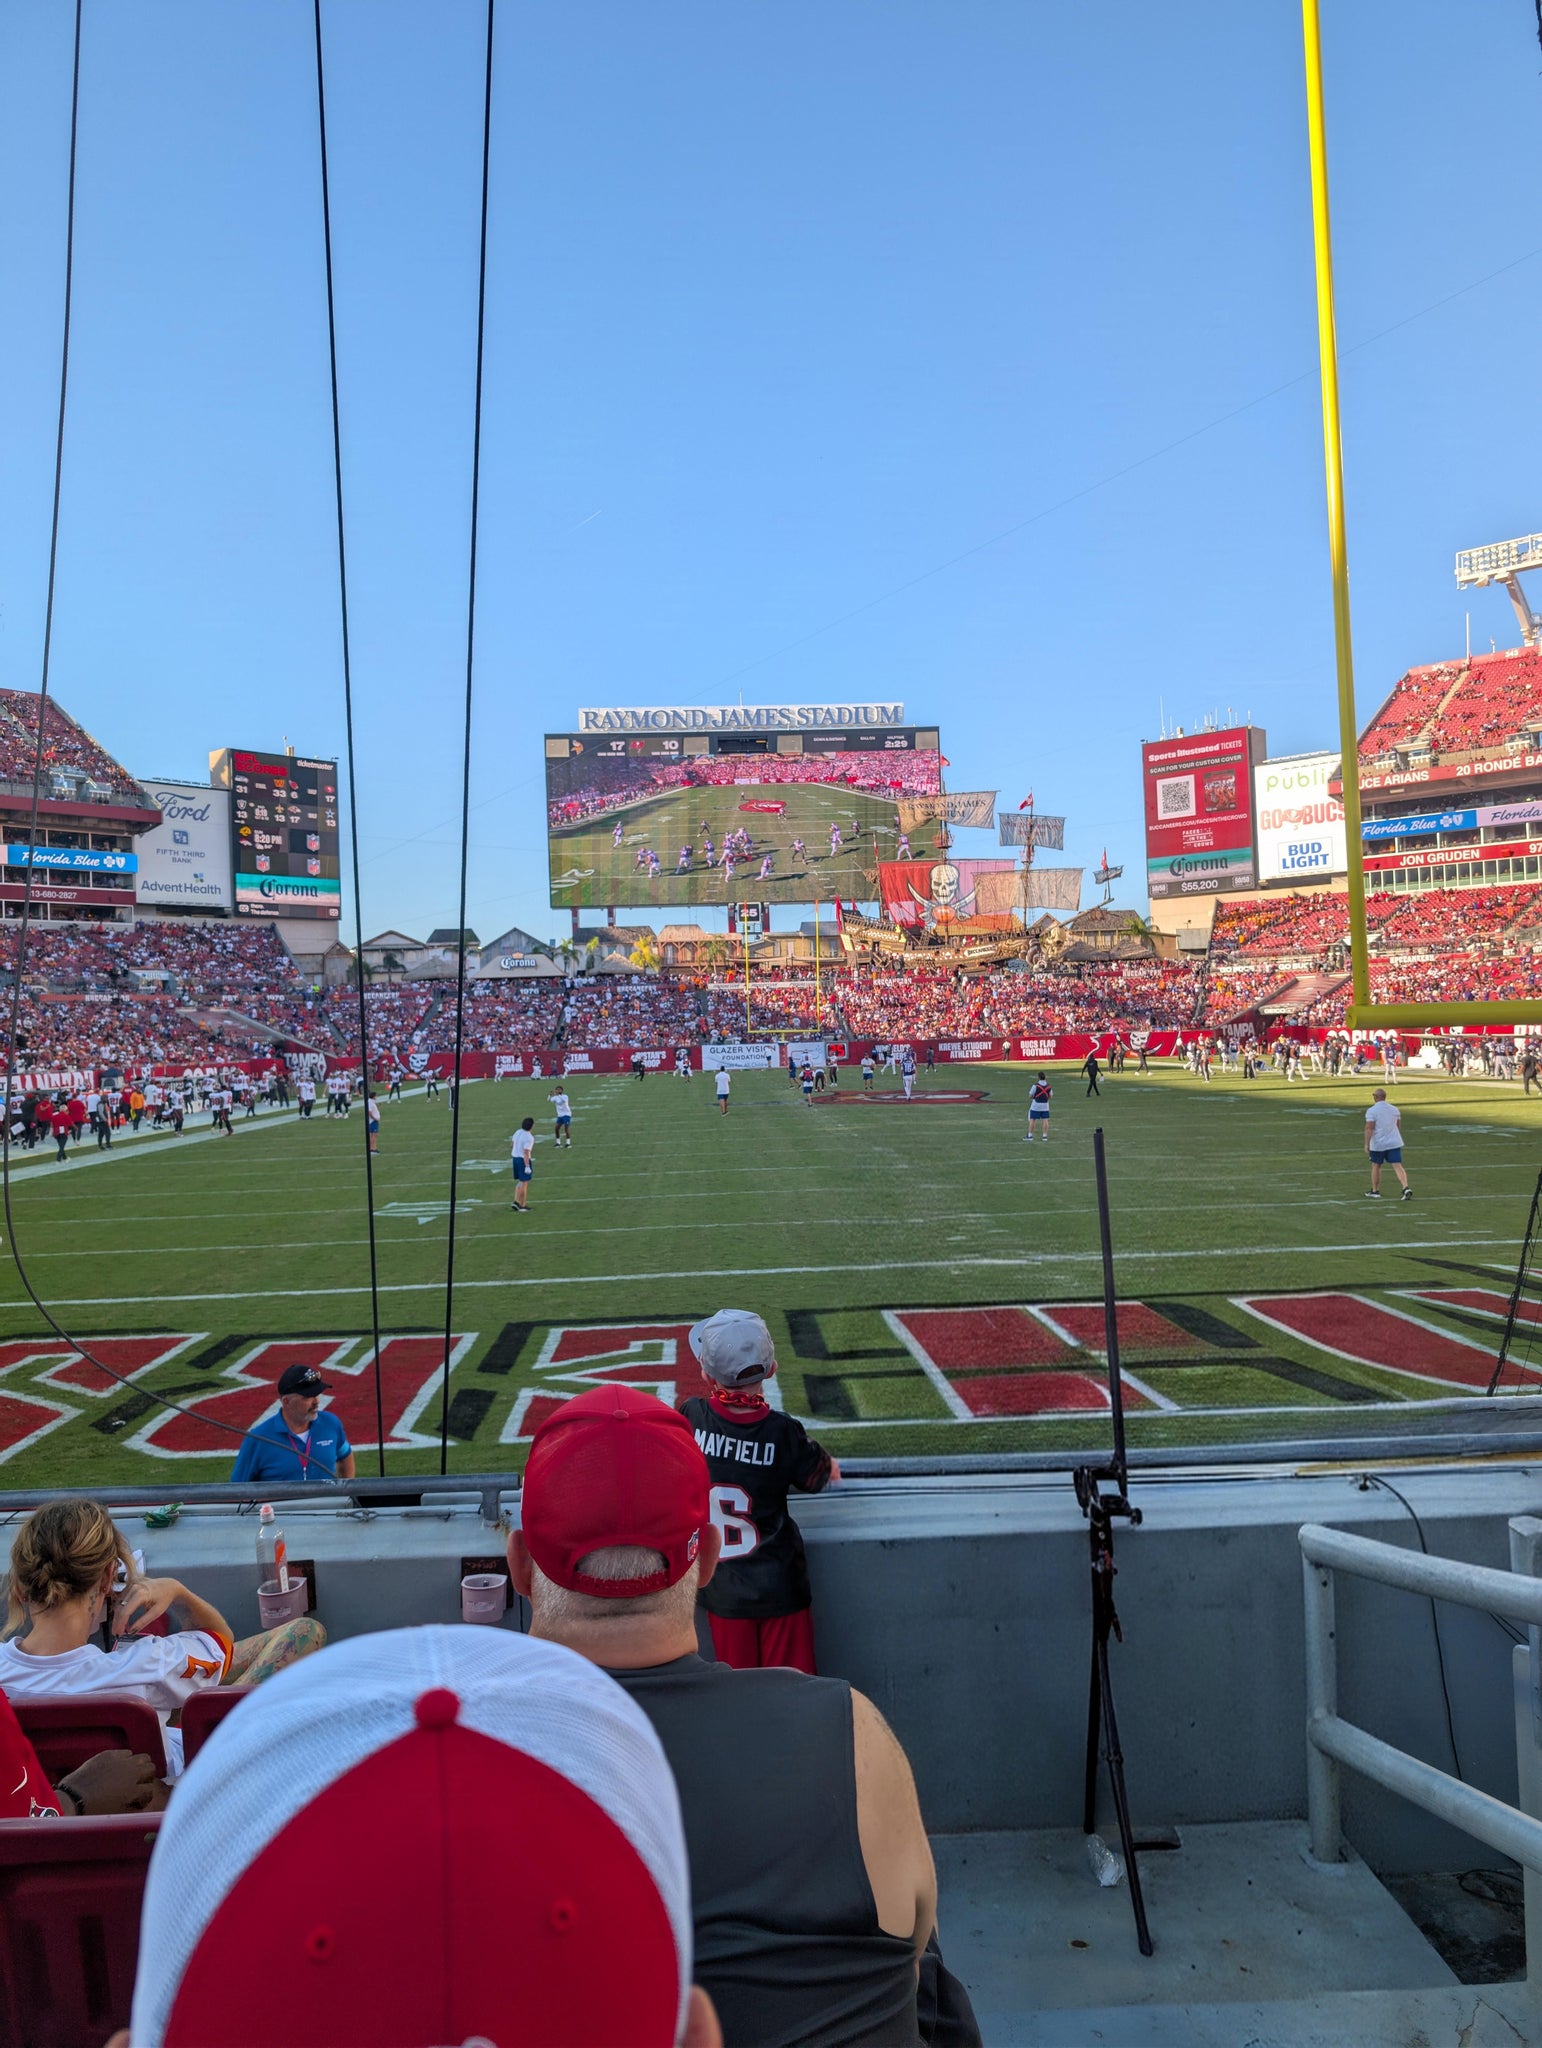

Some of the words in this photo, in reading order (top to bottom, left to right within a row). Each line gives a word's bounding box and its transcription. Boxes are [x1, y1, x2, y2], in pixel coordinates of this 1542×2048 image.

[583, 710, 708, 729] RAYMOND
[711, 708, 795, 728] JAMES
[796, 705, 901, 726] STADIUM
[610, 741, 626, 751] 17
[662, 740, 679, 750] 10
[884, 740, 908, 749] 2:29
[234, 752, 256, 762] NFL
[1148, 751, 1177, 762] Sports
[1177, 744, 1220, 758] Illustrated
[1220, 740, 1243, 750] TICKETS
[235, 761, 288, 777] SCORES
[297, 759, 334, 771] ticketmaster
[1149, 765, 1166, 774] SCAN
[1179, 761, 1195, 769] YOUR
[1195, 758, 1220, 767] CUSTOM
[1221, 754, 1242, 763] COVER
[1456, 765, 1471, 777] 20
[1474, 756, 1522, 774] RONDÉ
[1525, 754, 1542, 767] BA
[1383, 770, 1430, 786] ARIANS
[236, 785, 248, 794] 31
[272, 789, 287, 798] 33
[325, 795, 335, 803] 17
[955, 800, 987, 808] JAMES
[155, 791, 211, 822] Ford
[236, 810, 248, 819] 13
[274, 814, 286, 823] 13
[290, 815, 300, 824] 17
[1260, 808, 1283, 831] GO
[1490, 807, 1542, 822] Florida
[325, 819, 336, 827] 13
[1148, 813, 1248, 831] BUCCANEERS.COM/FACESINTHECROWD
[1362, 821, 1408, 837] Florida
[1410, 819, 1437, 832] Blue
[271, 836, 283, 845] PM
[156, 848, 180, 856] FIFTH
[182, 850, 206, 858] THIRD
[1288, 842, 1322, 857] BUD
[22, 851, 71, 866] Florida
[73, 855, 100, 866] Blue
[1282, 853, 1330, 870] LIGHT
[1399, 853, 1424, 867] JON
[1427, 849, 1480, 864] GRUDEN
[1169, 857, 1229, 878] Corona
[260, 878, 318, 899] Corona
[1181, 879, 1219, 892] $55,200
[29, 889, 77, 899] 13-680-2827
[501, 957, 536, 969] Corona
[1221, 1022, 1255, 1037] TAMPA
[709, 1044, 743, 1054] GLAZER
[938, 1042, 961, 1051] KREWE
[962, 1041, 992, 1051] STUDENT
[1020, 1040, 1037, 1049] BUCS
[1039, 1040, 1056, 1048] FLAG
[950, 1049, 982, 1058] ATHLETES
[1022, 1047, 1055, 1056] FOOTBALL
[283, 1053, 327, 1072] TAMPA
[694, 1428, 775, 1466] MAYFIELD
[708, 1483, 760, 1562] 6
